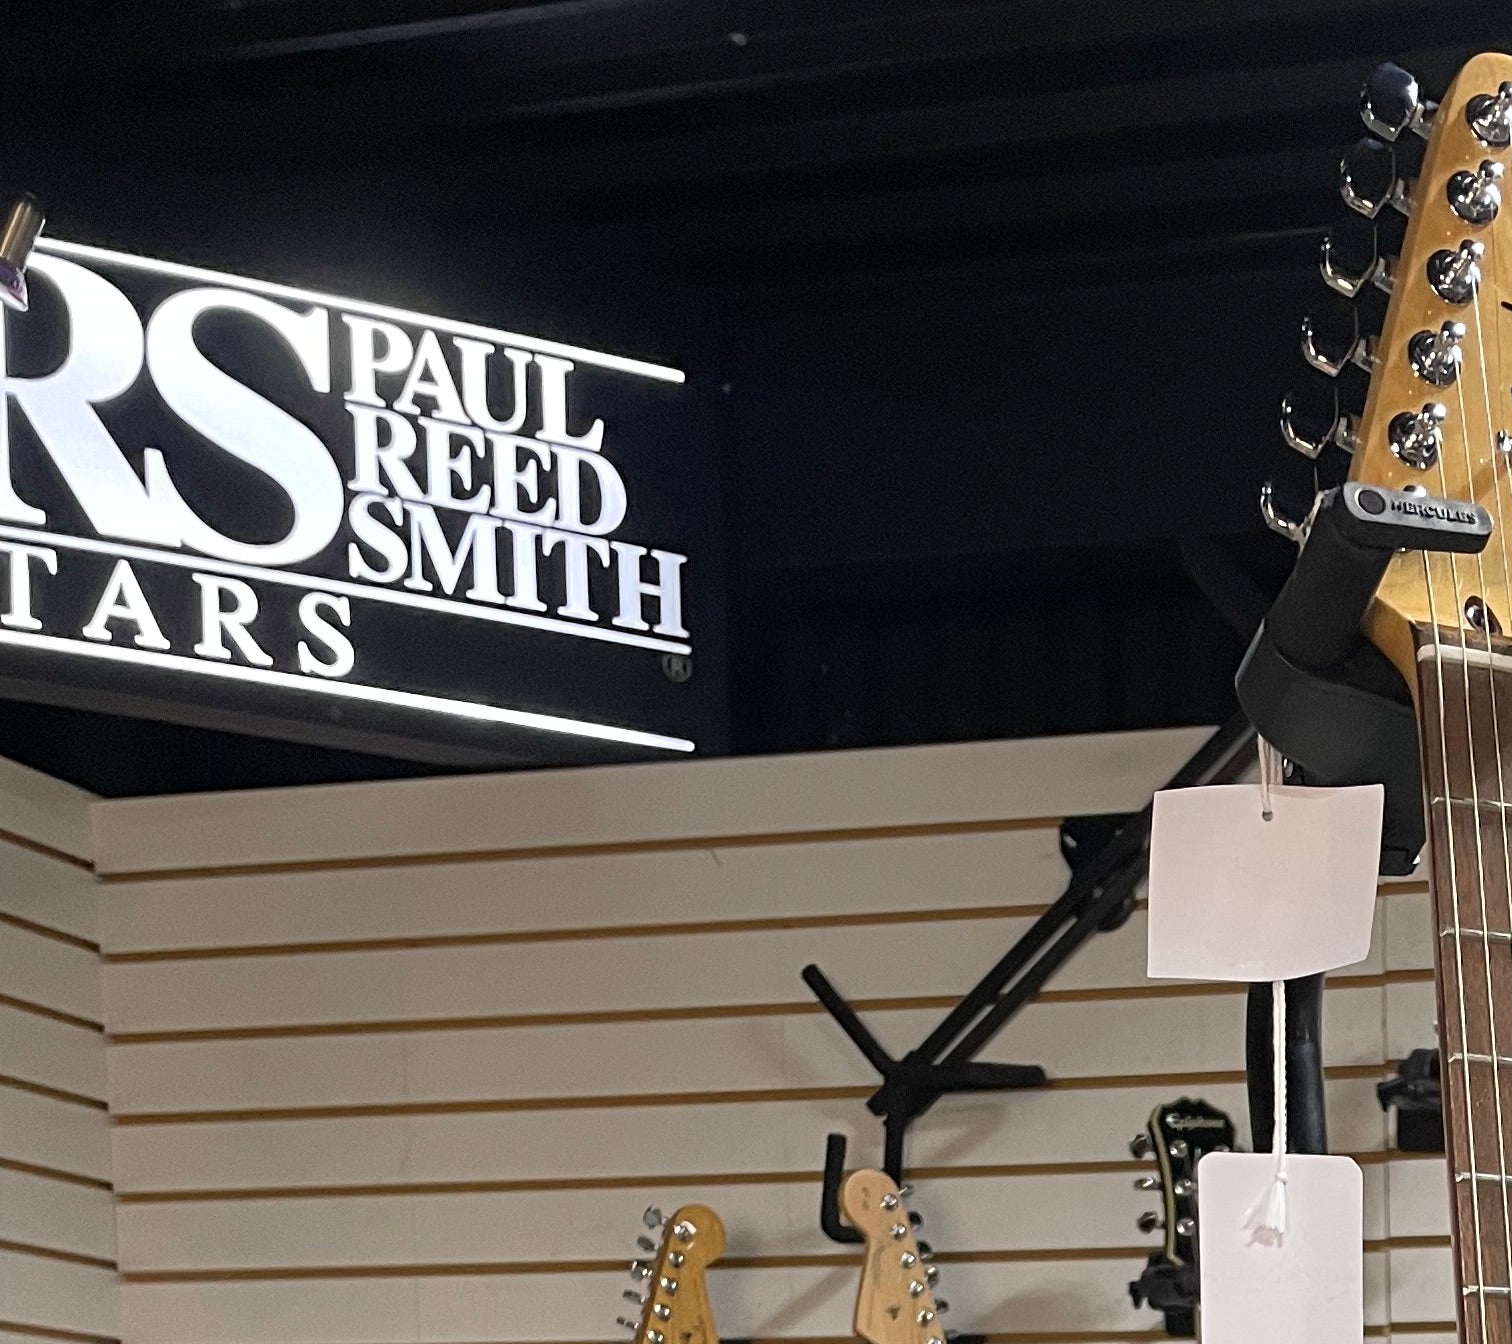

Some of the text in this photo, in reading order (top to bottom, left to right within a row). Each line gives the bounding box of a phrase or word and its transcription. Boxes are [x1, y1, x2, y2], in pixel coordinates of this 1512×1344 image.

[342, 312, 604, 452] PAUL
[345, 401, 628, 537] REED
[1391, 499, 1476, 525] HERCULES
[348, 492, 690, 638] SMITH
